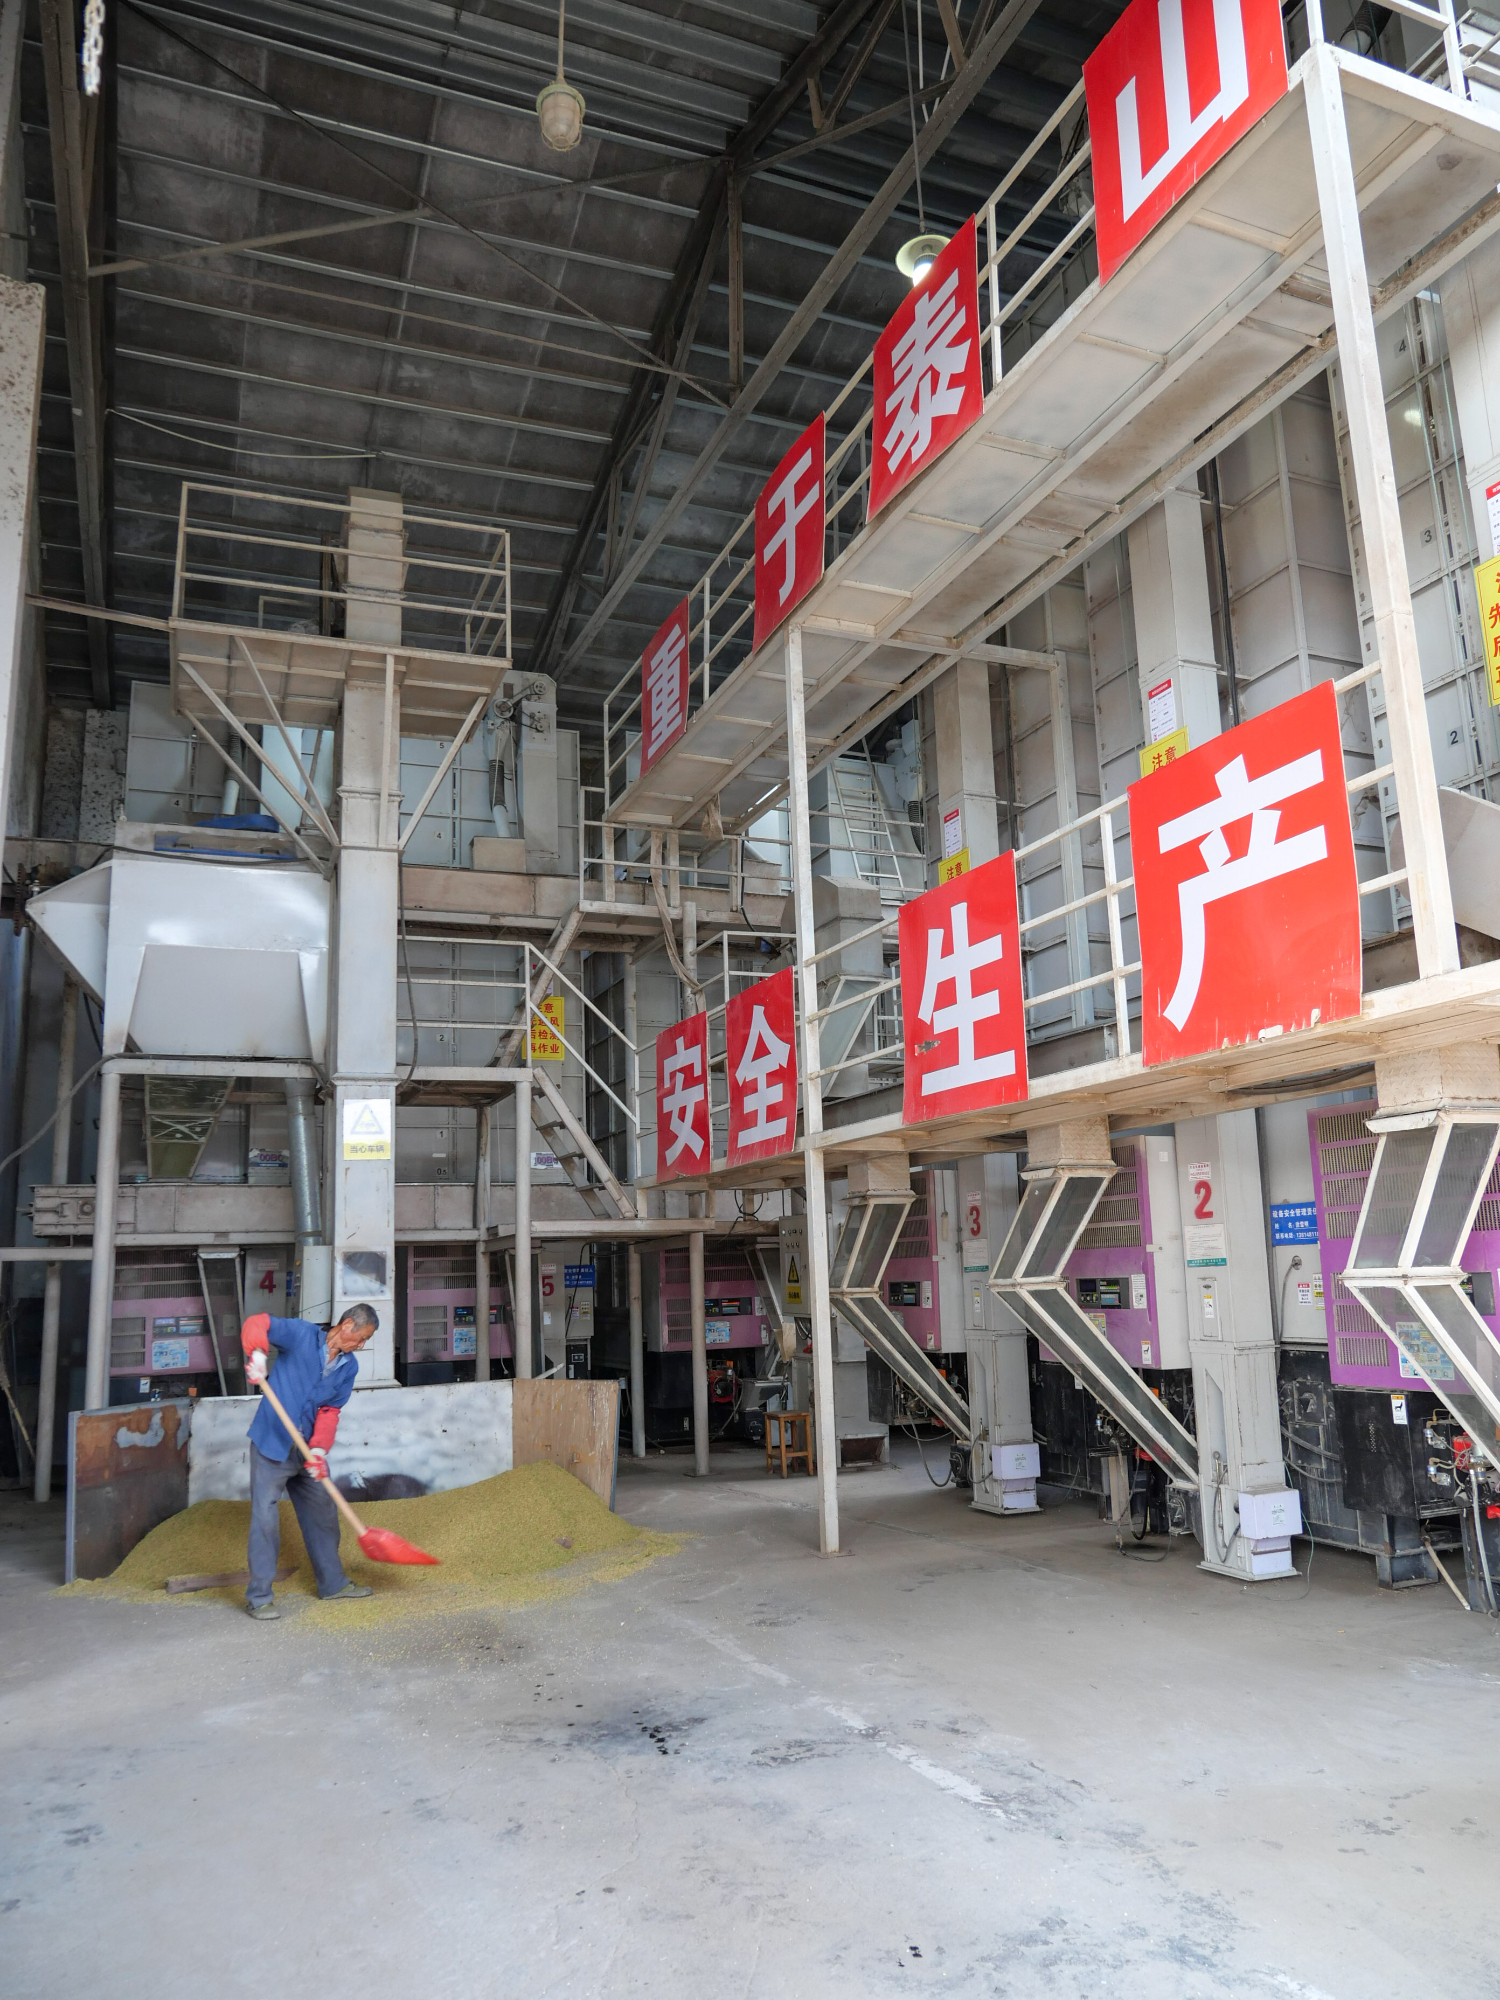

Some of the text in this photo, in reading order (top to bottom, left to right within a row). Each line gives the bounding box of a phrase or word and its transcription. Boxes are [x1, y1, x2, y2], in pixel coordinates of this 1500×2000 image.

[1398, 339, 1407, 352] 4
[1424, 529, 1433, 543] 3
[1449, 730, 1459, 745] 2
[946, 862, 963, 881] 注意
[350, 1144, 385, 1154] 当心车辆
[1194, 1180, 1214, 1220] 2
[969, 1206, 981, 1236] 3
[259, 1270, 277, 1294] 4
[541, 1275, 555, 1297] 5
